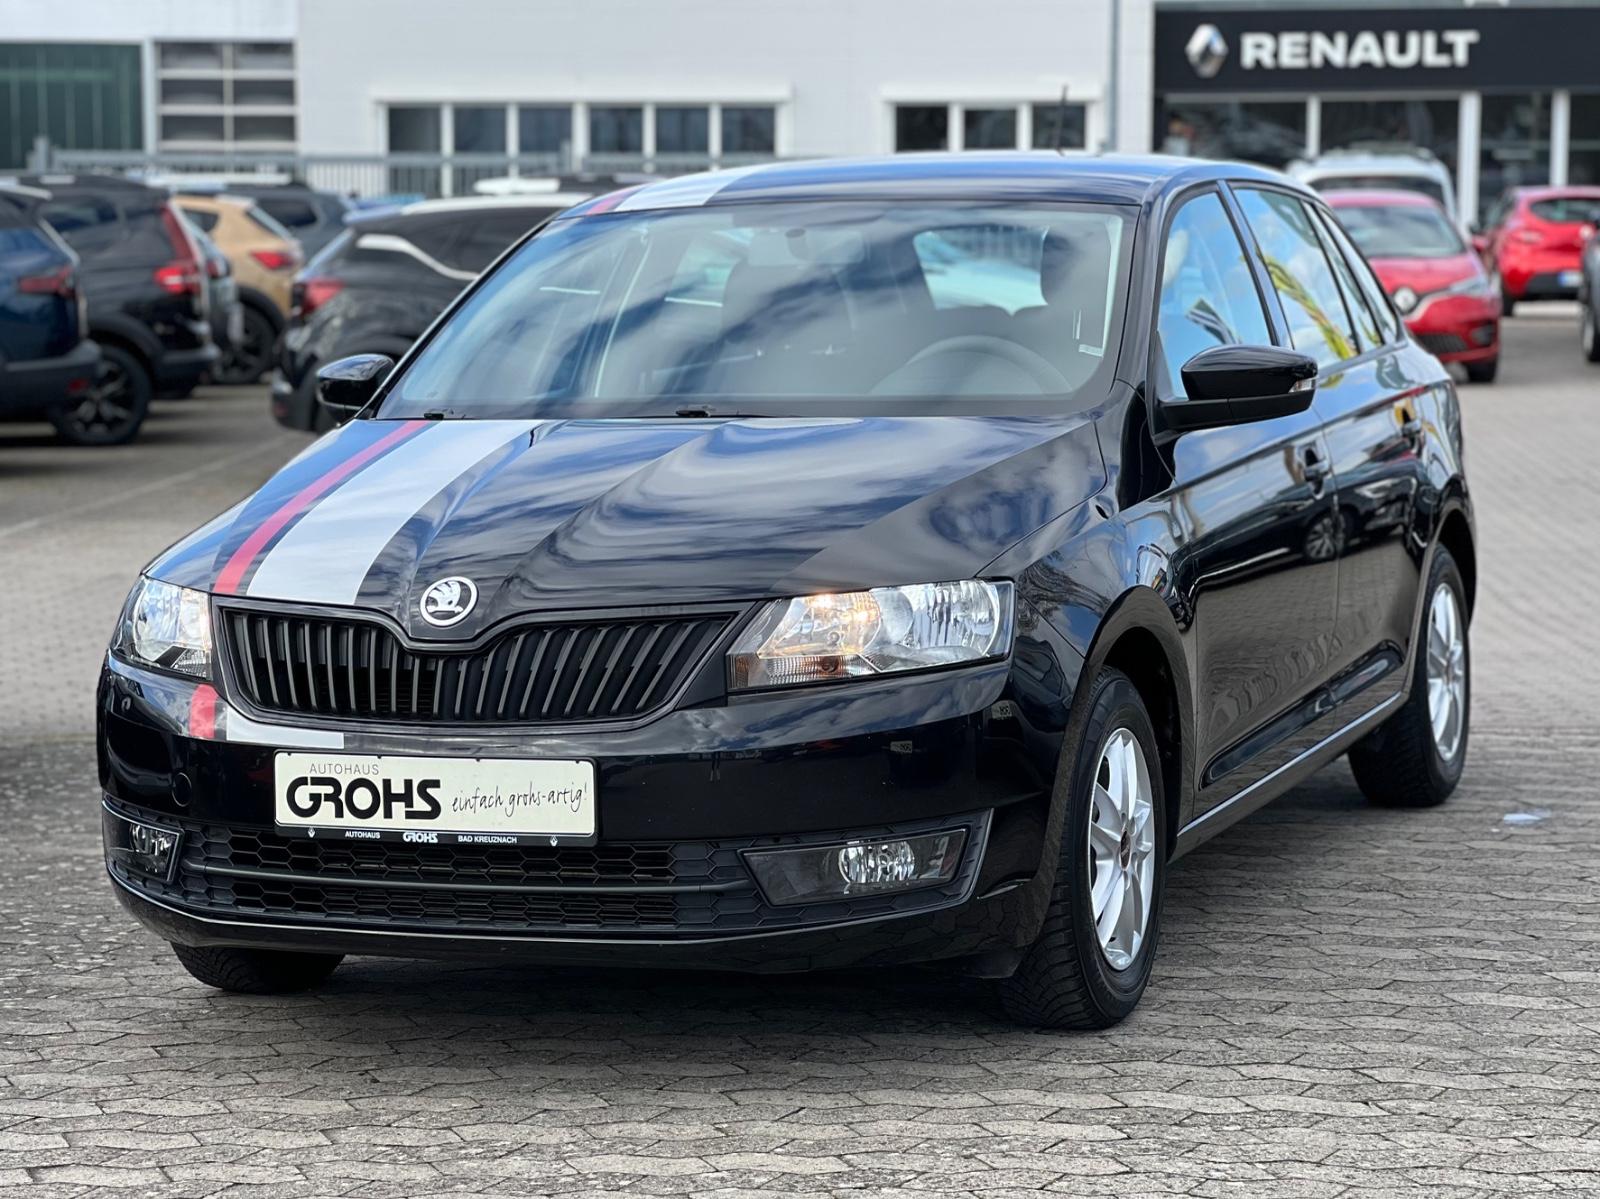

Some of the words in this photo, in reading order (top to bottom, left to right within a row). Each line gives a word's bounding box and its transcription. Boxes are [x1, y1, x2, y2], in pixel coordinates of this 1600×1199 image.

[1240, 30, 1480, 69] RENAULT
[309, 763, 380, 776] AUTOHAUS
[286, 776, 442, 820] GROHS
[452, 785, 504, 814] einfach
[505, 781, 588, 817] grohs-artig!
[344, 831, 381, 839] AUTOHAUS
[402, 831, 439, 843] GROHS
[457, 835, 473, 843] BAD
[474, 836, 518, 844] KREUZNACH
